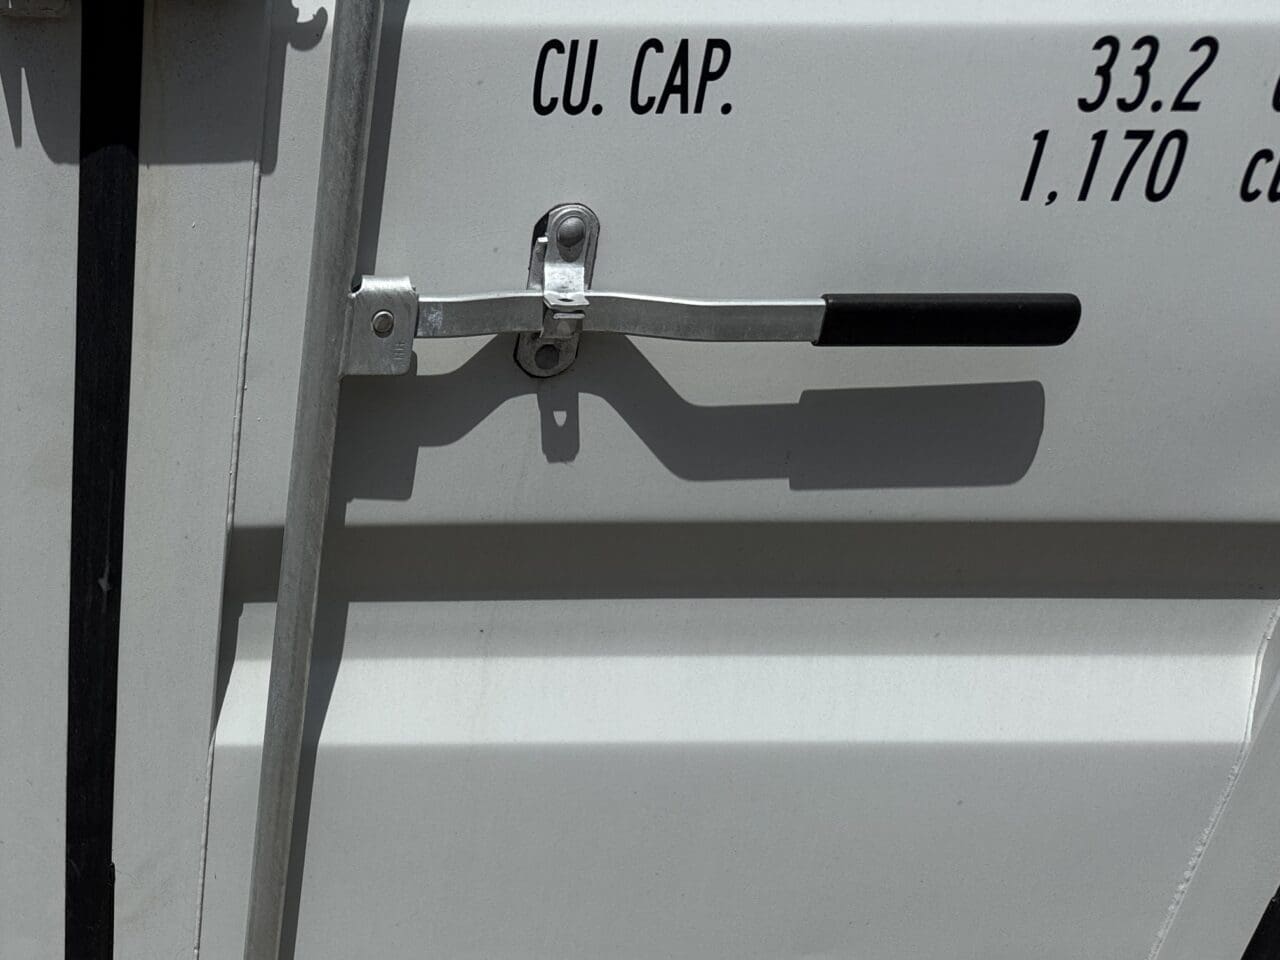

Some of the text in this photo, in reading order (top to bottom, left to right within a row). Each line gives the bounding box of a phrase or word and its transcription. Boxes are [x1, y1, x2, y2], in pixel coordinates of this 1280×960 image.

[532, 38, 734, 117] CU. CAP.
[1077, 35, 1220, 114] 33.2
[1020, 129, 1190, 206] 1,170
